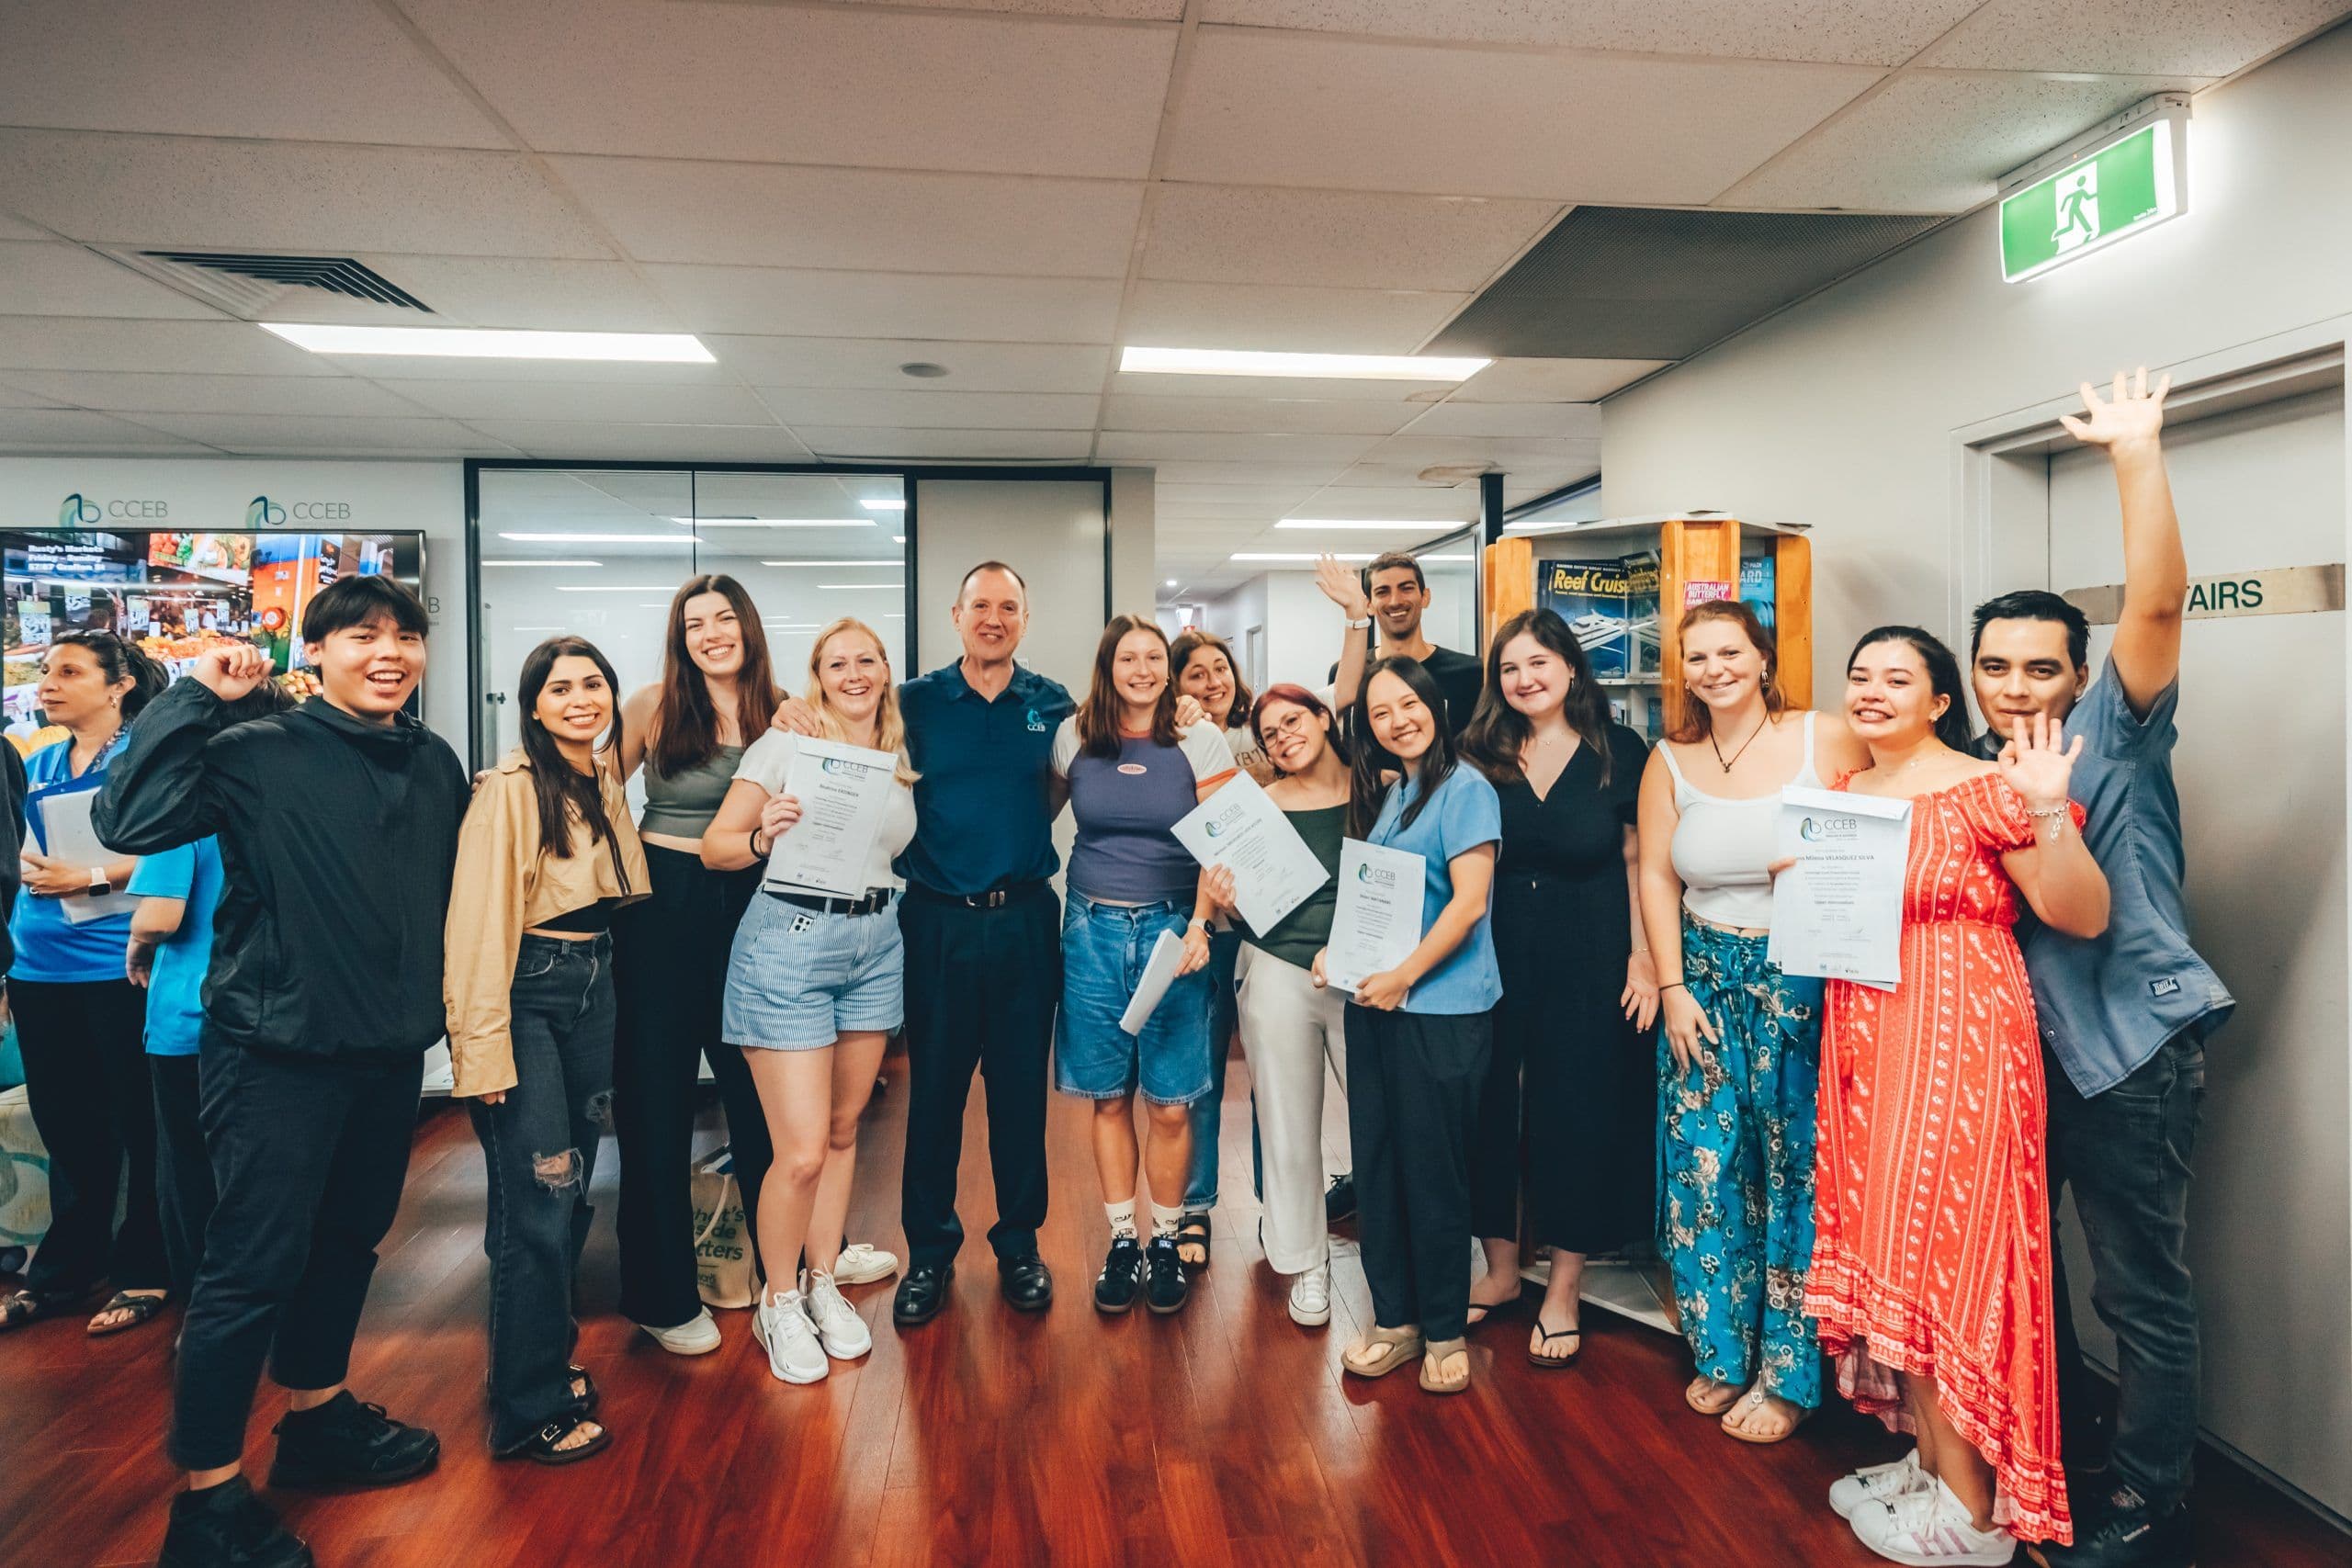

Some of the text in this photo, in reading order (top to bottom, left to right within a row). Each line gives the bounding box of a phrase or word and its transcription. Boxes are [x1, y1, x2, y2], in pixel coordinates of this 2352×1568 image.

[108, 500, 168, 518] CCEB
[293, 502, 351, 520] CCEB
[1554, 569, 1589, 591] Reef
[1739, 570, 1762, 583] ARD
[1687, 582, 1730, 591] AUSTRALIAN
[1688, 590, 1726, 598] BUTTERFLY
[2187, 579, 2264, 612] AIRS
[1824, 818, 1858, 830] CCEB
[1374, 868, 1396, 881] CCEB
[696, 1239, 743, 1260] tters
